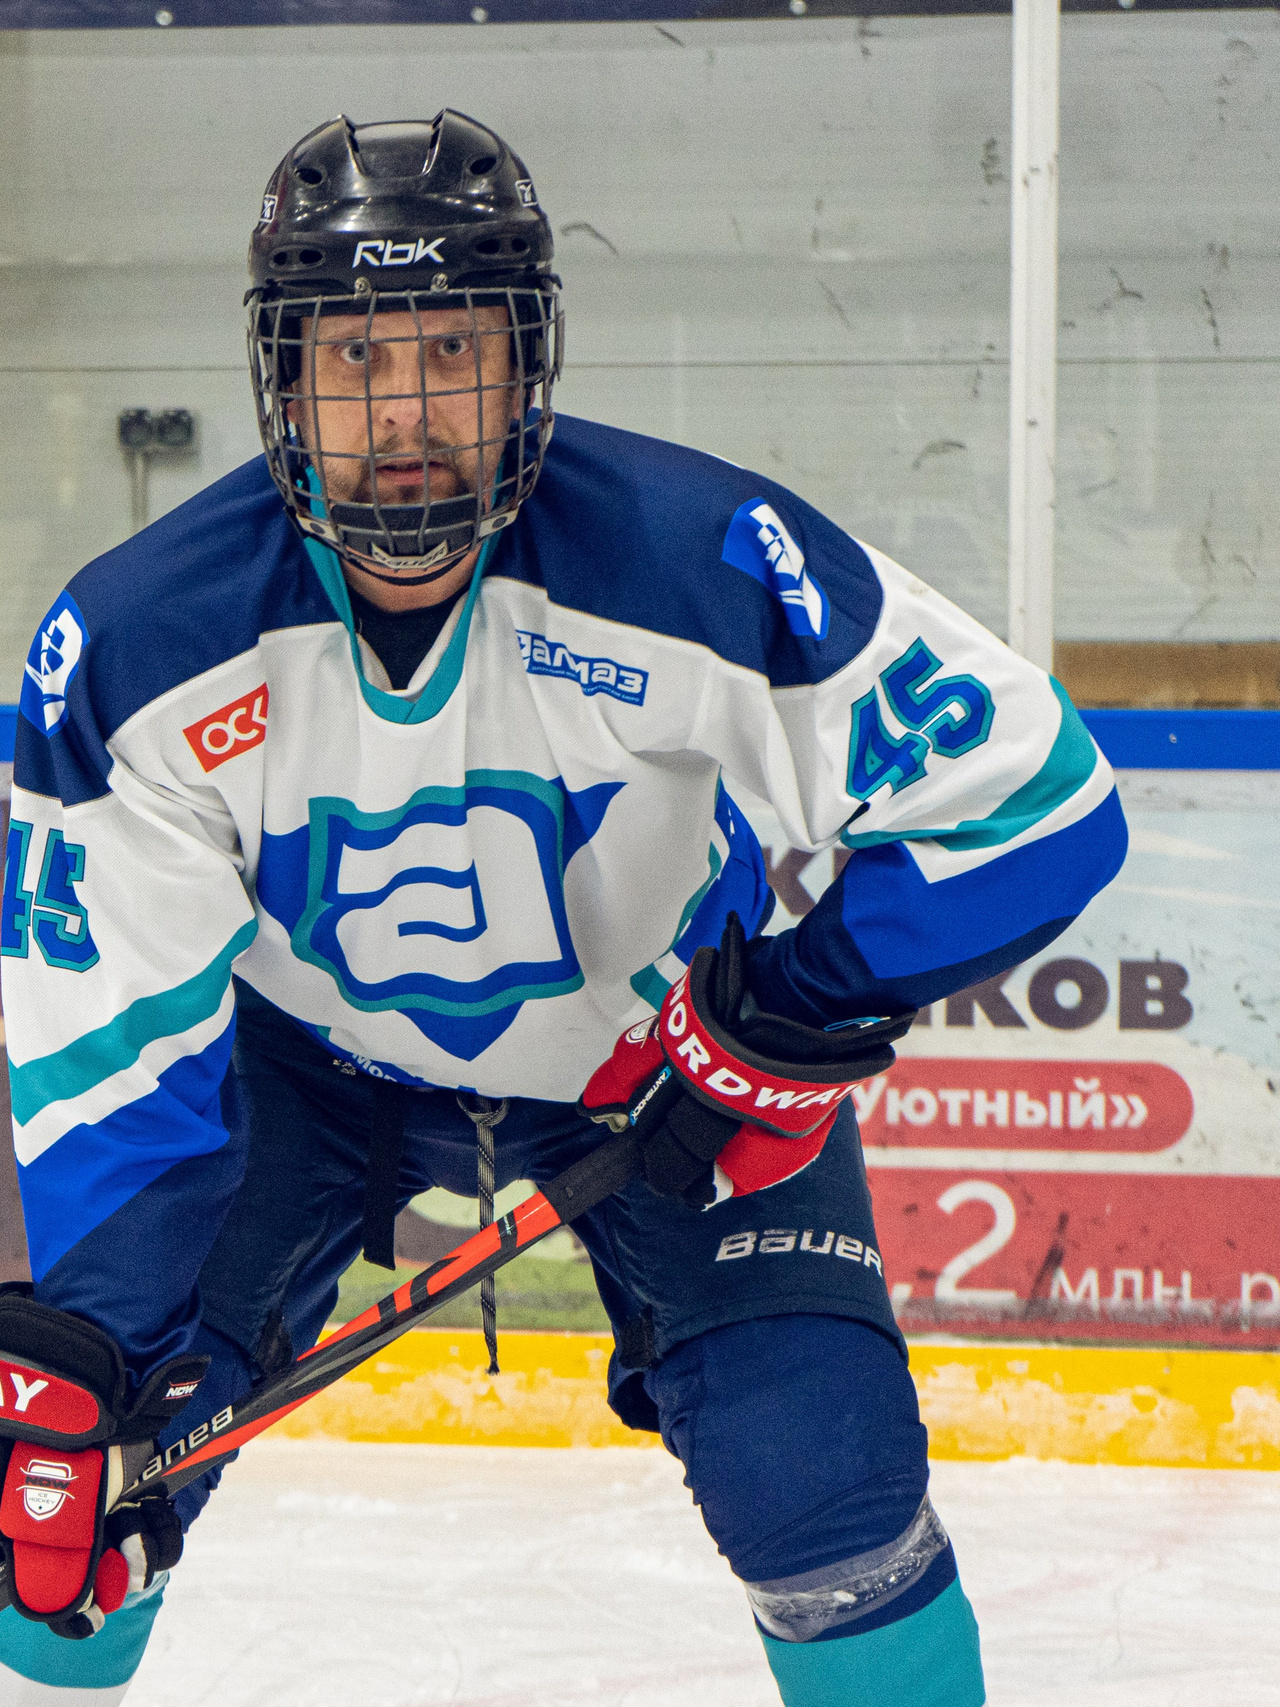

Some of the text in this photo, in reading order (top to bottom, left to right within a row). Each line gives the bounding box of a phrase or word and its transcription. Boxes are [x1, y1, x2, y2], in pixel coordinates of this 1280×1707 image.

[846, 635, 996, 802] 45
[915, 956, 1195, 1033] КОВ
[855, 1075, 1148, 1130] Уютный»
[166, 1383, 197, 1398] NOW
